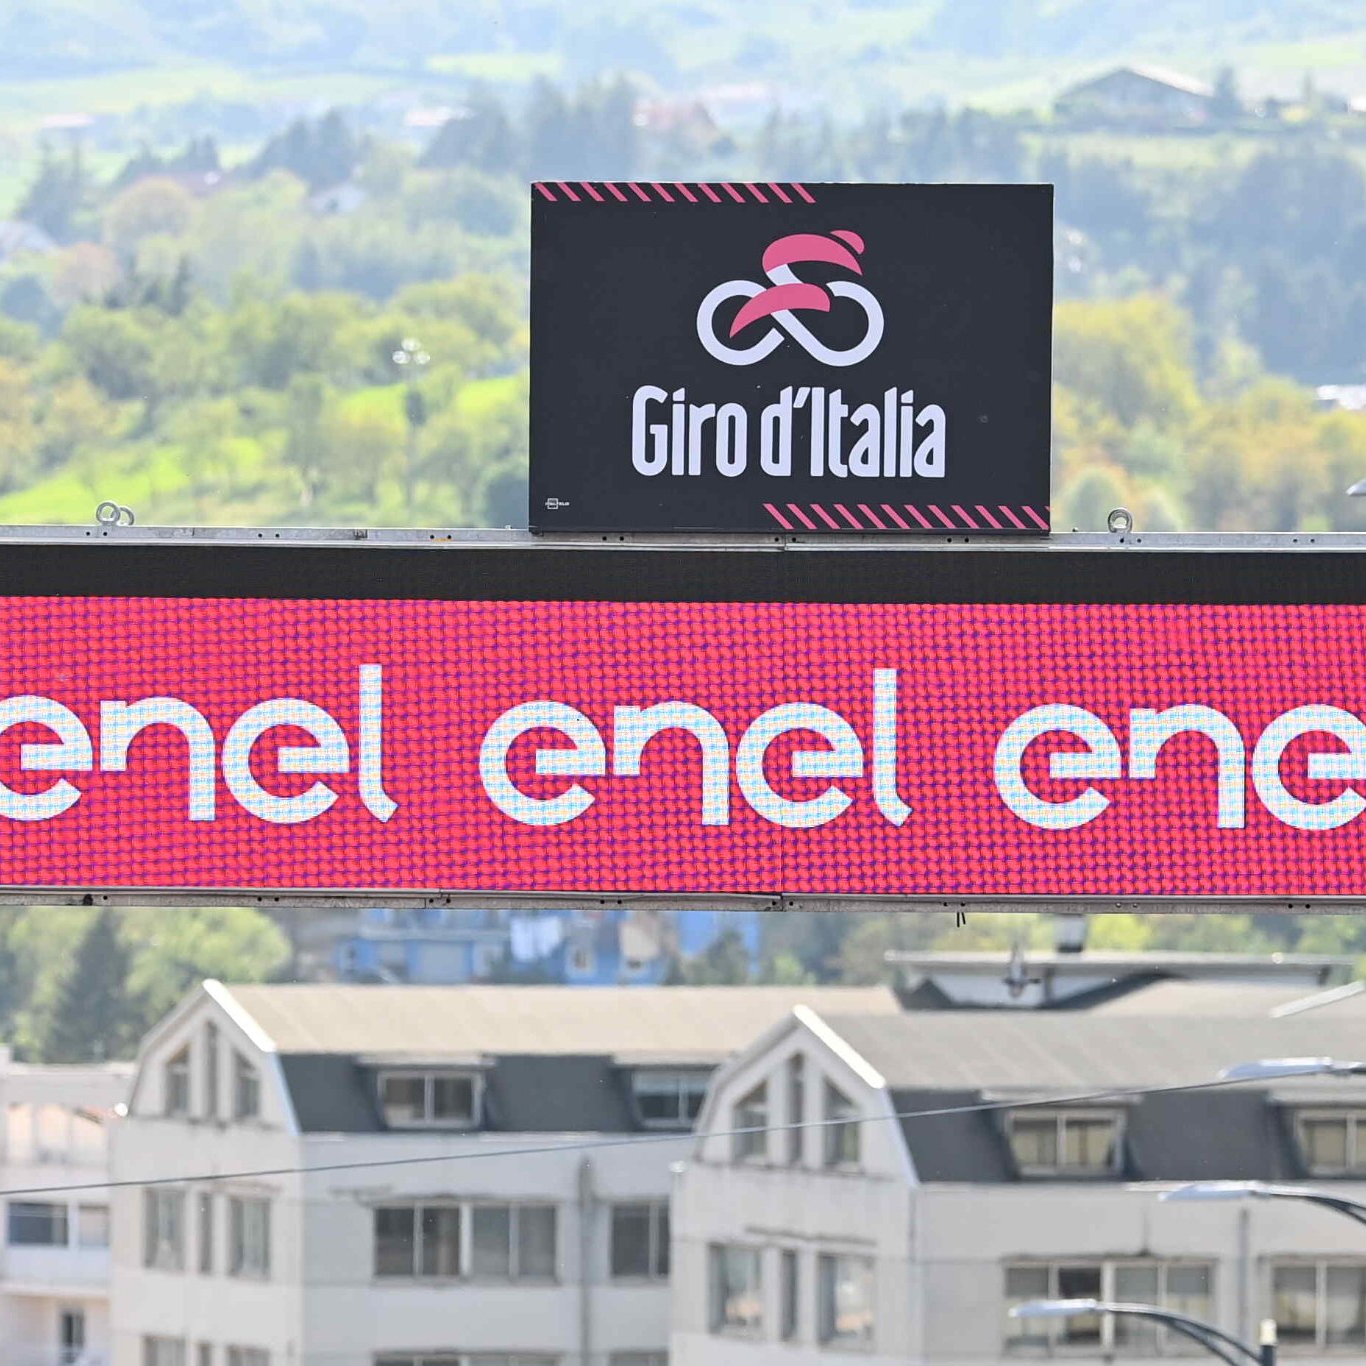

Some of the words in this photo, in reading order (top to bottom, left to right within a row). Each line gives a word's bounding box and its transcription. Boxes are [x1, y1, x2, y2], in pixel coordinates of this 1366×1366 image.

[631, 384, 748, 478] Giro
[760, 386, 947, 479] d'Italia
[479, 667, 913, 829] enel
